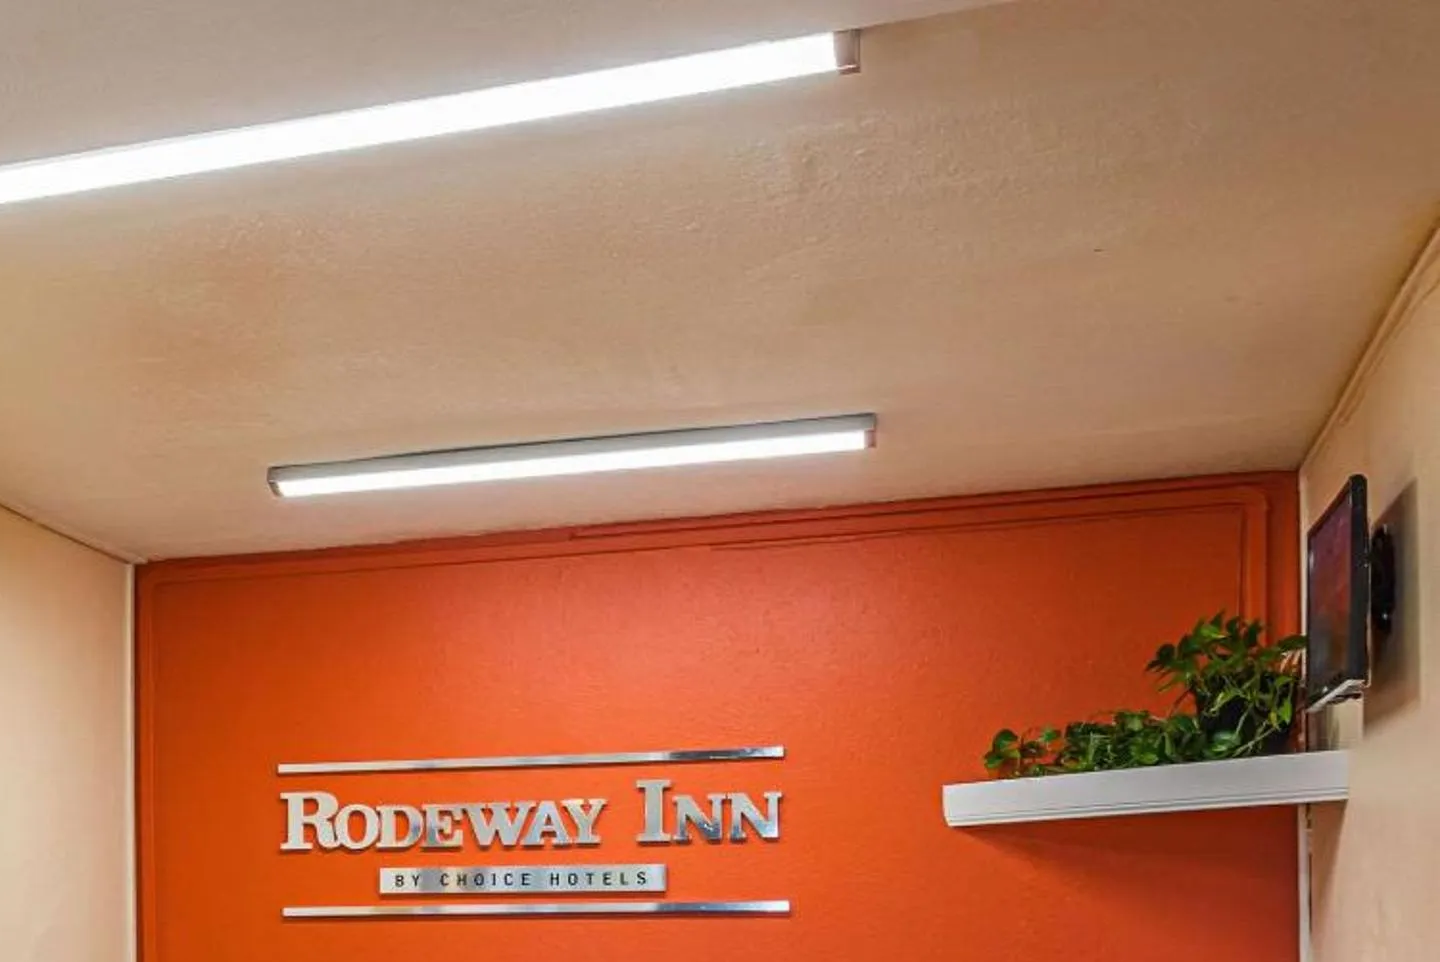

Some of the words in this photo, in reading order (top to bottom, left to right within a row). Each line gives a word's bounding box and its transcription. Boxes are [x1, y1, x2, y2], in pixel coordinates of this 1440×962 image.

[279, 791, 607, 851] RODEWAY
[636, 779, 782, 843] INN
[394, 874, 421, 888] BY
[439, 872, 531, 887] CHOICE
[549, 871, 648, 886] HOTELS
